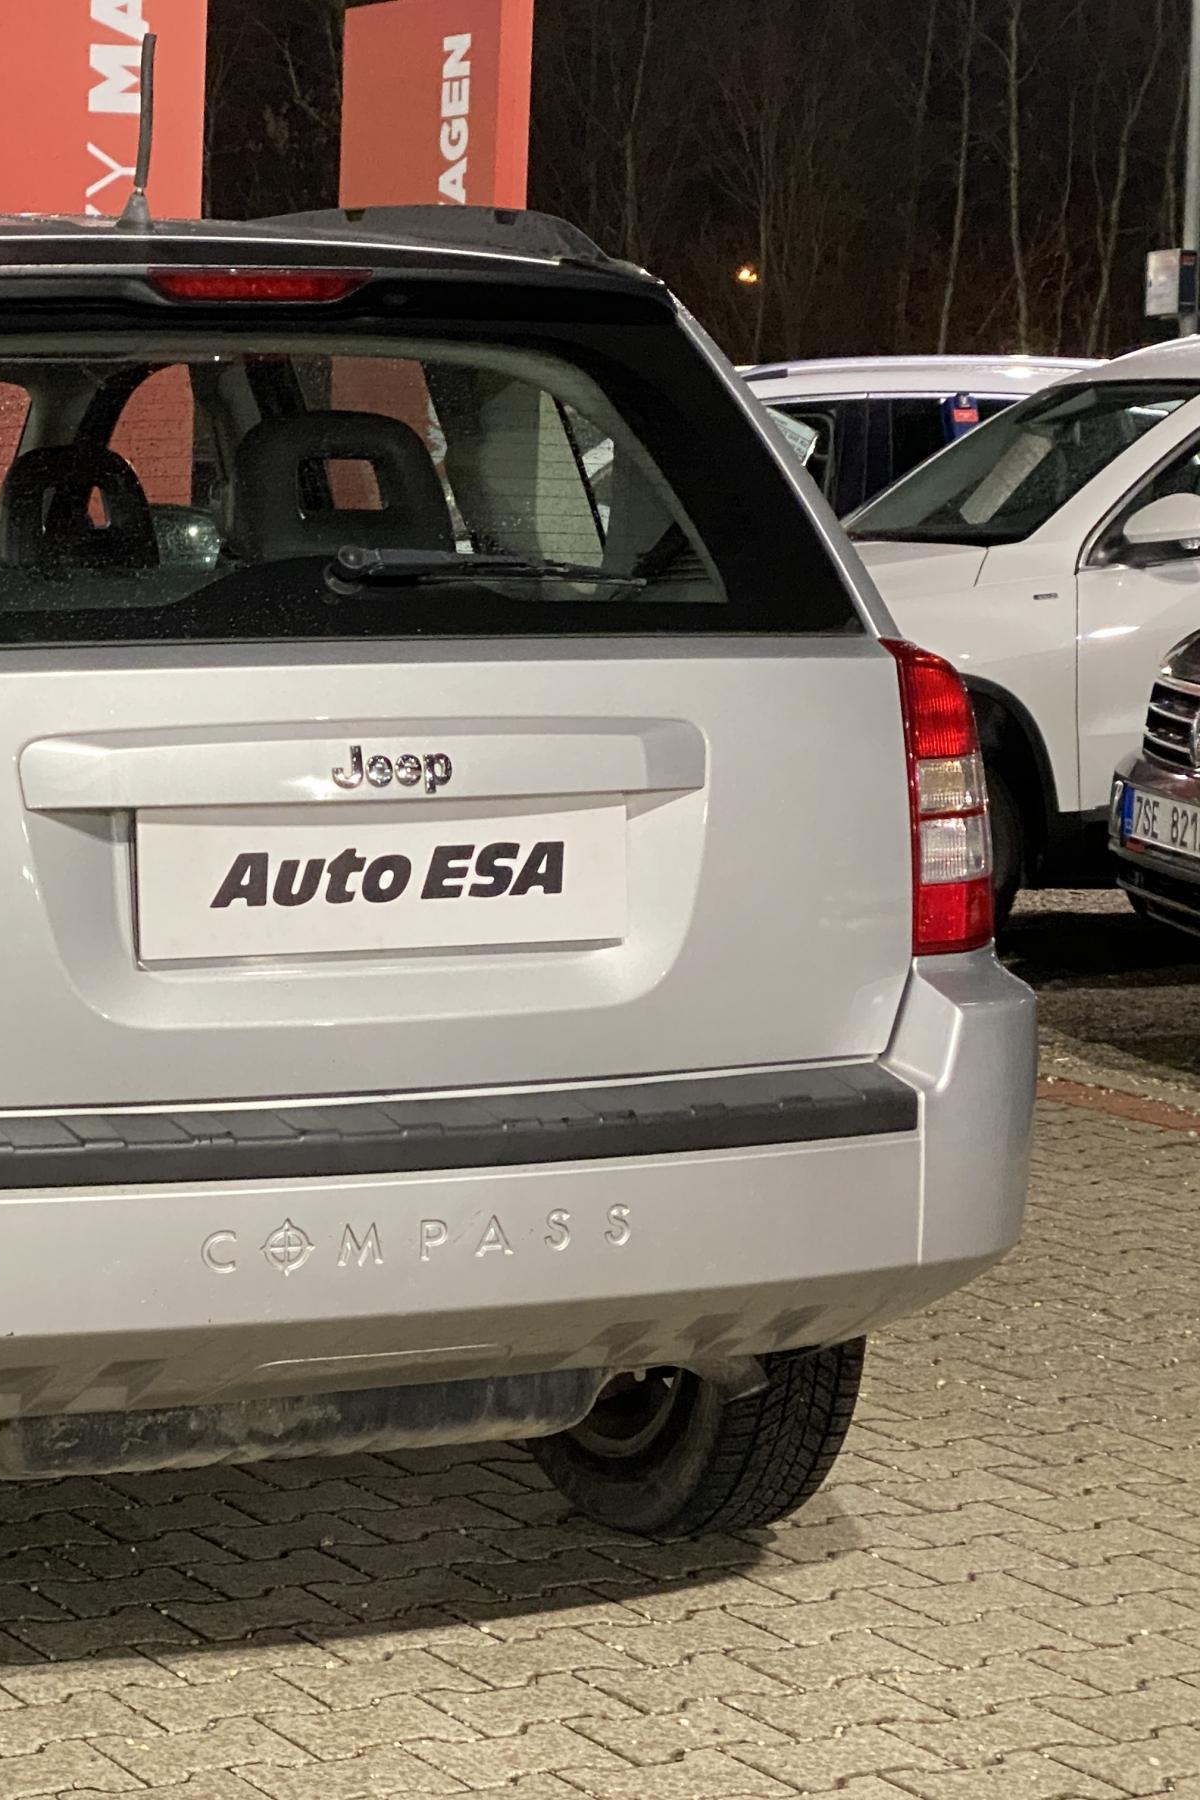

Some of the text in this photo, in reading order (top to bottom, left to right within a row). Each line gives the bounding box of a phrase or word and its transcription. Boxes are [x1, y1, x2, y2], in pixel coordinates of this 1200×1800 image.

[438, 33, 471, 206] AGEN
[85, 142, 137, 216] Y
[331, 744, 452, 793] Jeep
[1134, 796, 1200, 851] 7SE 821
[210, 841, 564, 908] Auto ESA
[201, 1203, 632, 1276] COMPASS
